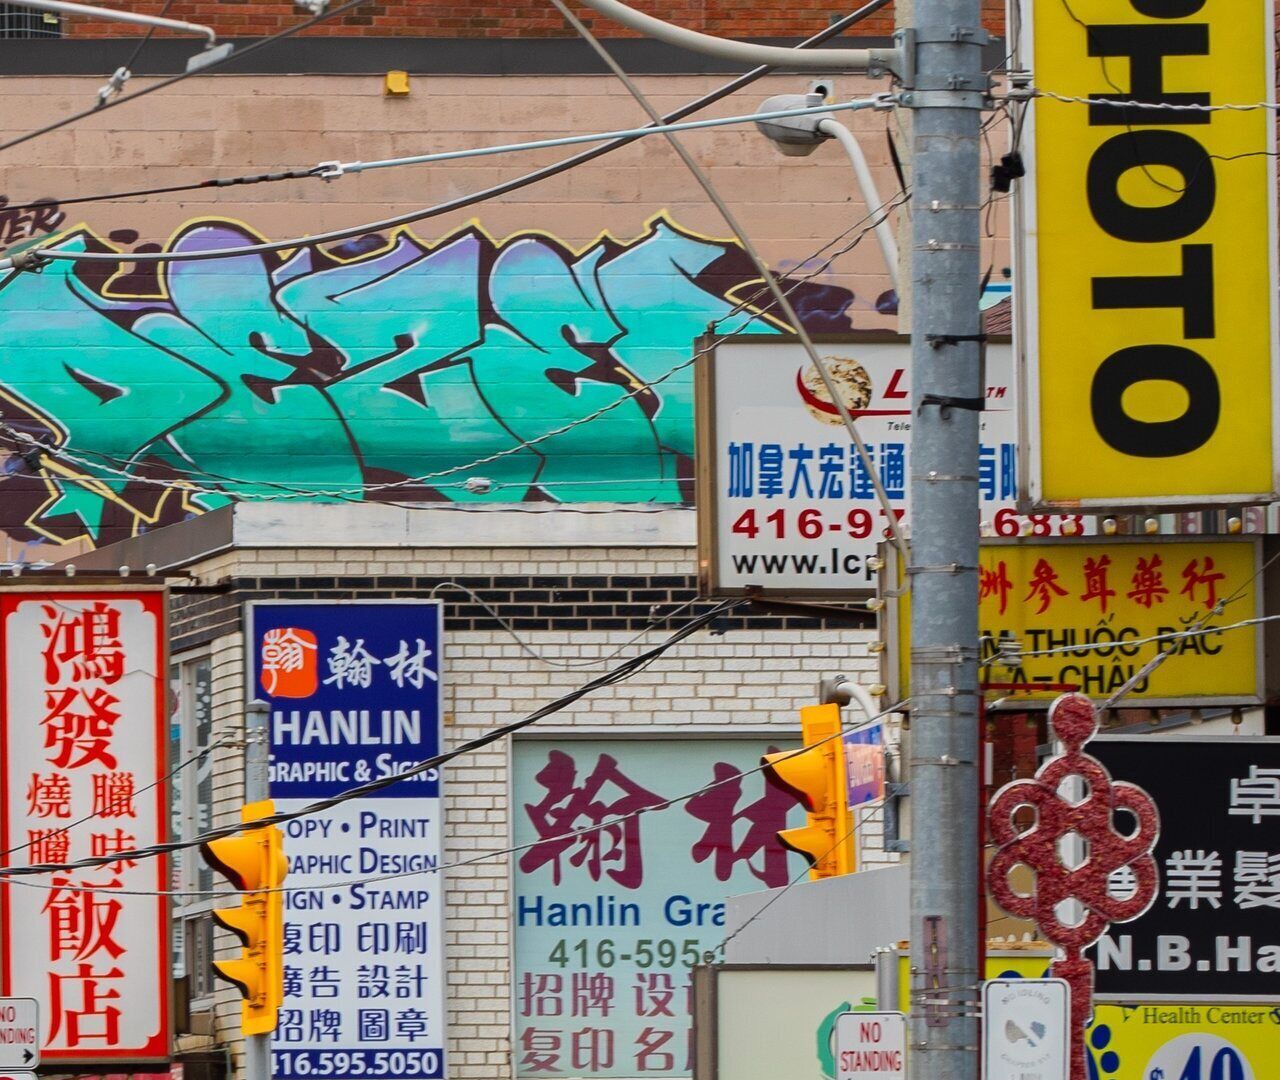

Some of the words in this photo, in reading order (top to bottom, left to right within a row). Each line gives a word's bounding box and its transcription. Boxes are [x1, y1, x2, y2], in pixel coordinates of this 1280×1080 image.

[1086, 0, 1222, 458] HOTO
[322, 635, 438, 690] 翰林
[40, 600, 124, 770] 鴻發
[273, 710, 421, 745] HANLIN
[359, 811, 430, 838] PRINT
[288, 855, 352, 874] APHIC
[359, 848, 437, 874] DESIGN
[286, 891, 323, 910] IGN
[349, 883, 429, 910] STAMP
[518, 896, 639, 926] Hanlin
[357, 921, 427, 955] 印刷
[40, 875, 126, 1047] 飯店
[357, 964, 428, 998] 設計
[520, 972, 615, 1017] 招牌
[274, 1008, 342, 1042] 招牌
[357, 1008, 429, 1042] 圖章
[859, 1022, 882, 1043] NO
[1143, 1007, 1197, 1024] Health
[1206, 1007, 1265, 1024] Center
[519, 1027, 614, 1073] 复印
[840, 1052, 902, 1072] STANDING
